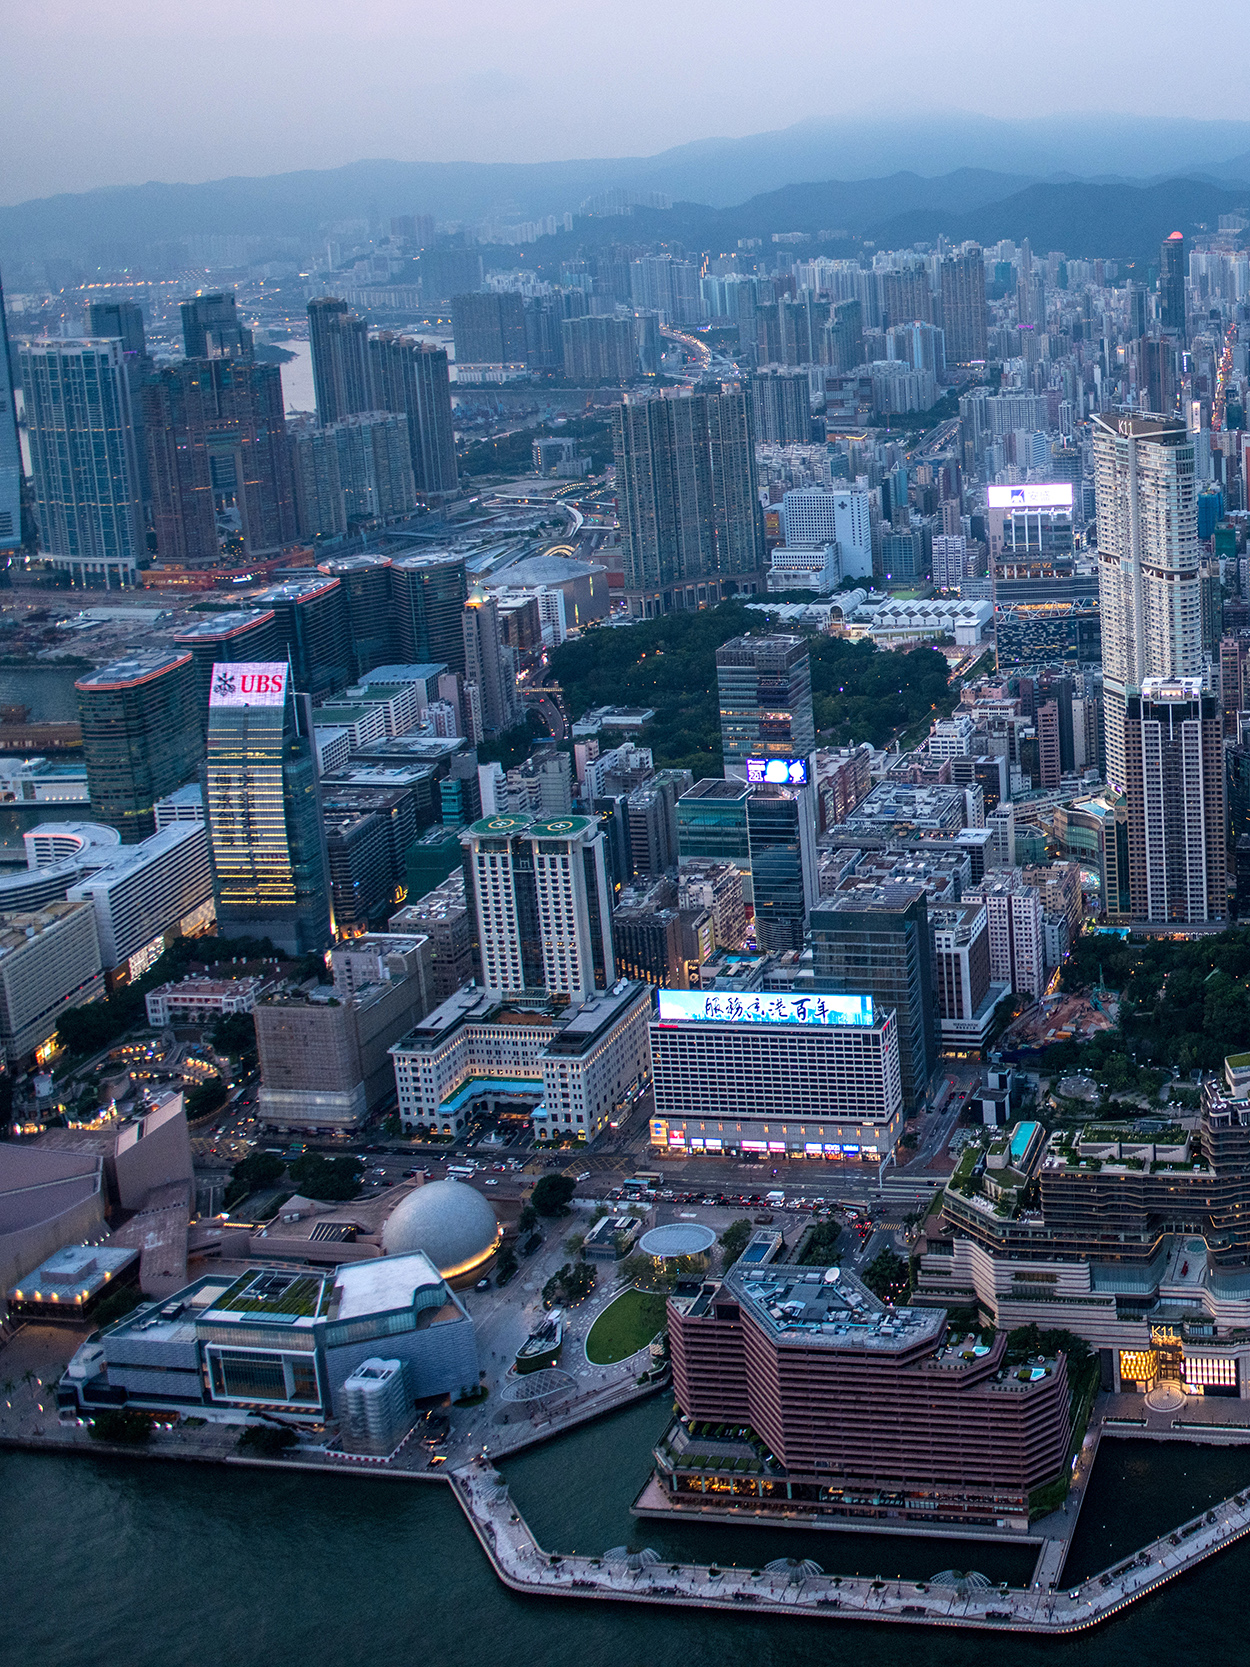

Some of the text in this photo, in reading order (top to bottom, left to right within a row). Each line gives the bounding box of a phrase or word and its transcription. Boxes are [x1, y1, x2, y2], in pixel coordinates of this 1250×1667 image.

[1118, 419, 1133, 436] K11
[240, 674, 283, 693] UBS
[1151, 1325, 1174, 1338] K11
